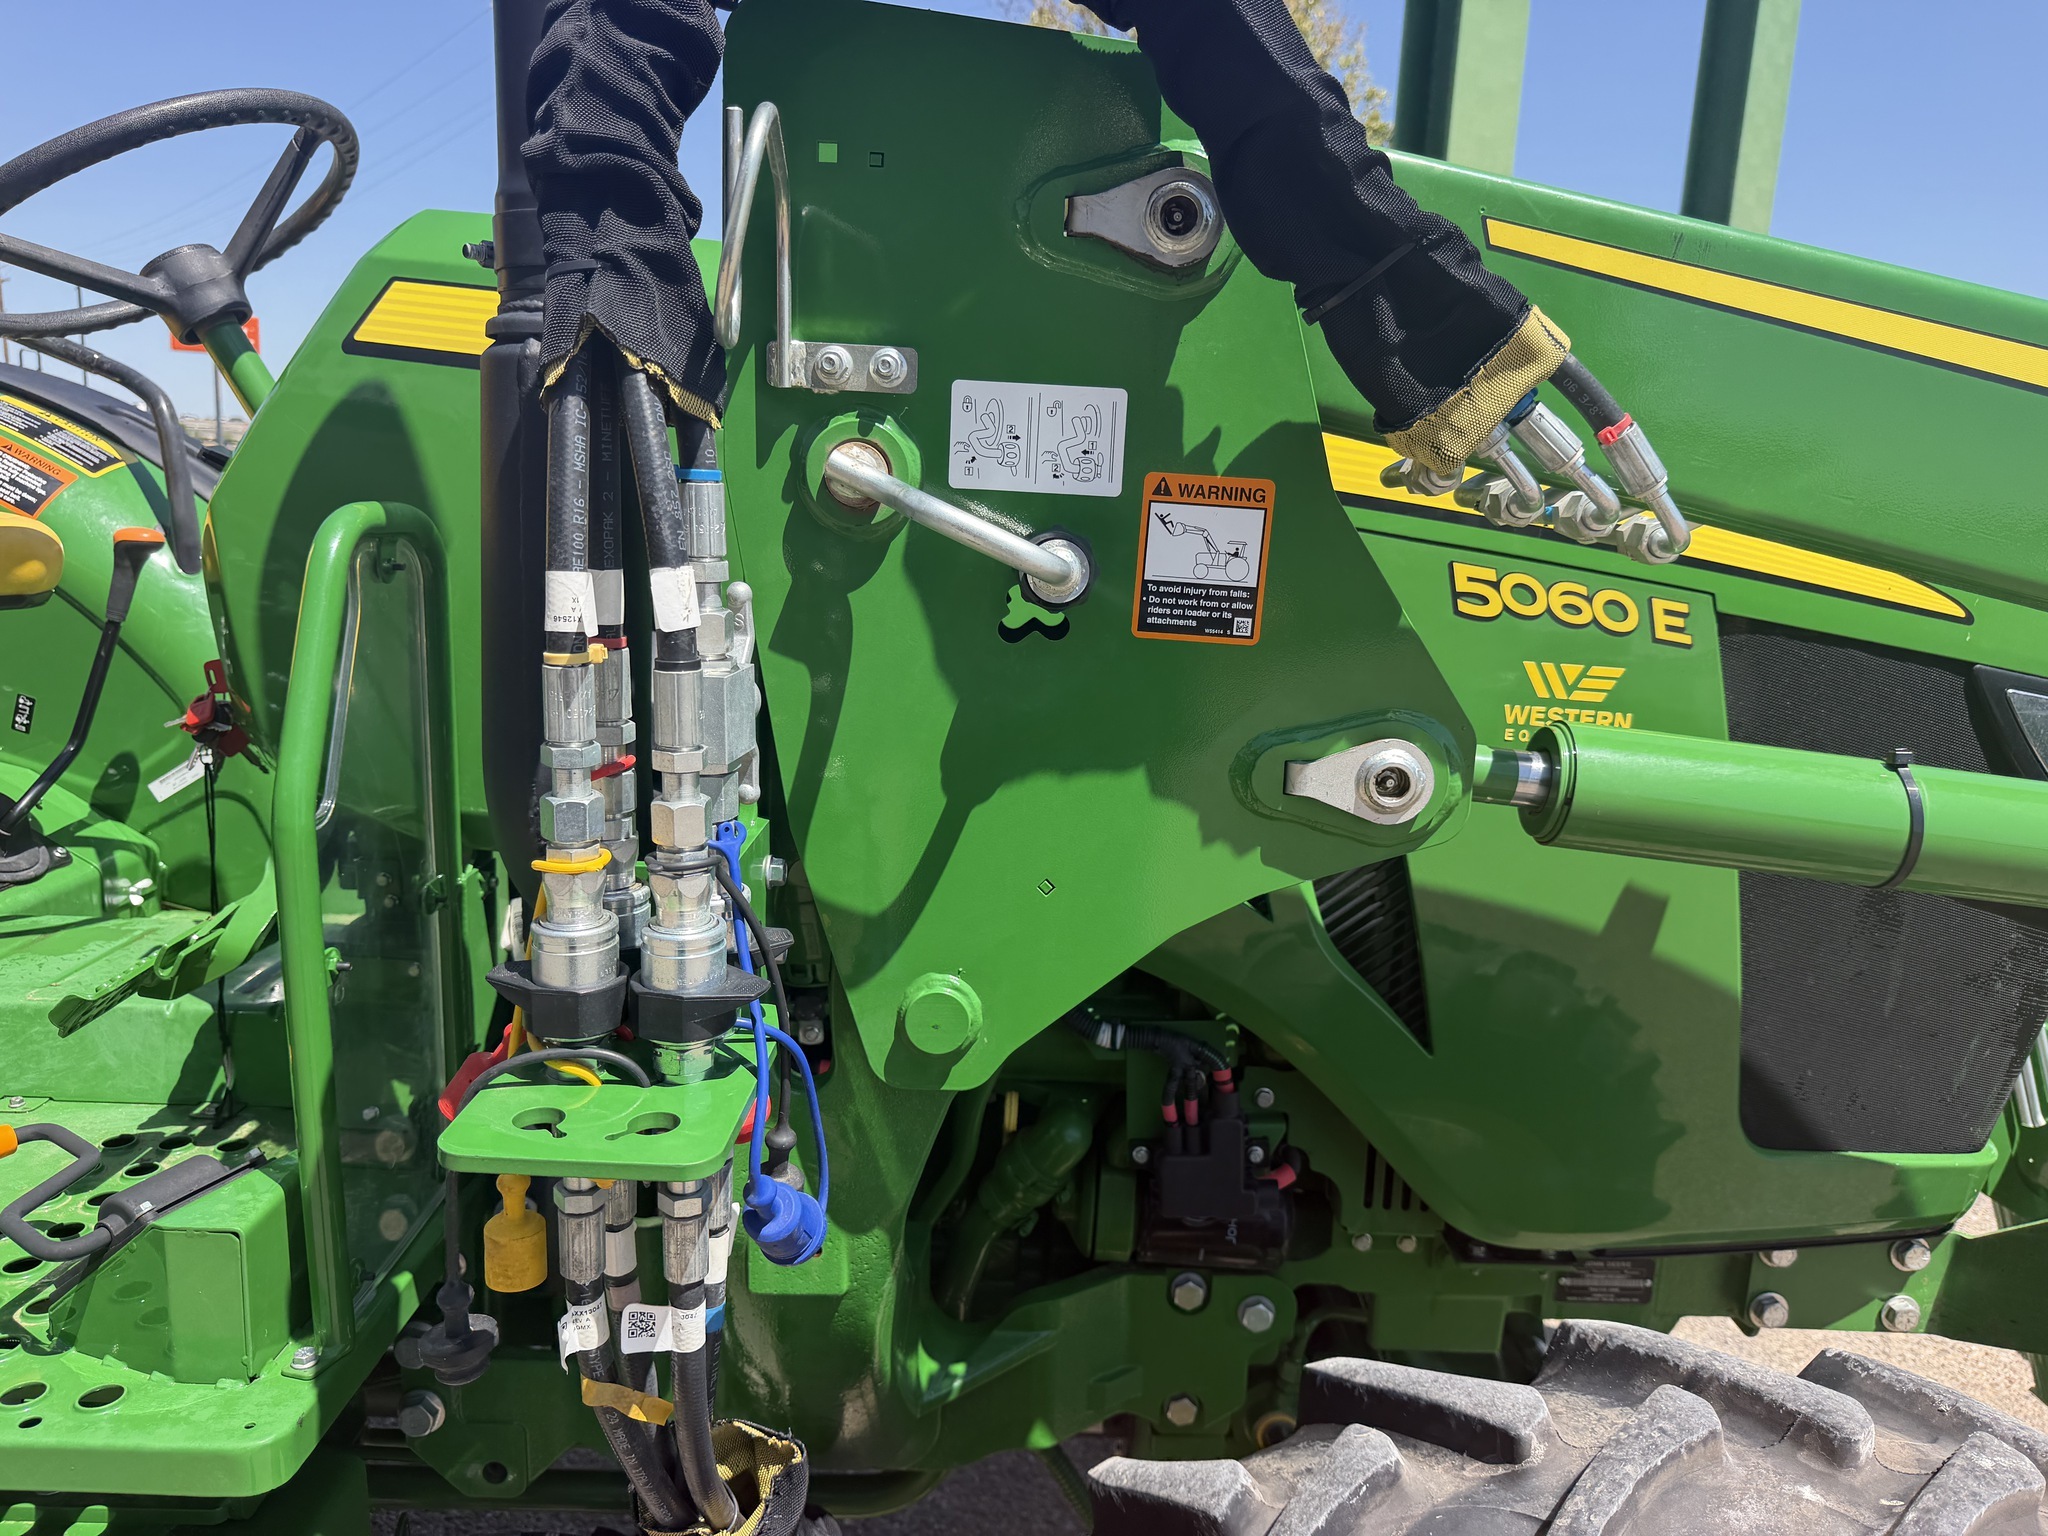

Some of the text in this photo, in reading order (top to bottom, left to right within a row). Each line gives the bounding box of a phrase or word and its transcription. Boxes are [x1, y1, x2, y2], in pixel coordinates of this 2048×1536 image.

[14, 448, 61, 476] WARNING
[574, 435, 586, 473] MSHA
[1178, 483, 1266, 504] WARNING
[573, 498, 586, 526] R16
[1147, 584, 1250, 598] To avoid injury from falls:
[1149, 595, 1160, 603] Do
[1162, 596, 1176, 605] not
[1177, 598, 1198, 606] work
[1200, 599, 1219, 608] from
[1231, 602, 1254, 610] allow
[1148, 605, 1171, 615] riders
[1184, 609, 1210, 618] loader
[1222, 610, 1232, 619] its
[1449, 561, 1693, 647] 5060 E
[1147, 616, 1197, 627] attachments
[1504, 704, 1633, 729] WESTERN
[613, 1427, 631, 1450] MADE
[625, 1453, 638, 1466] IN
[633, 1467, 653, 1489] ITALY
